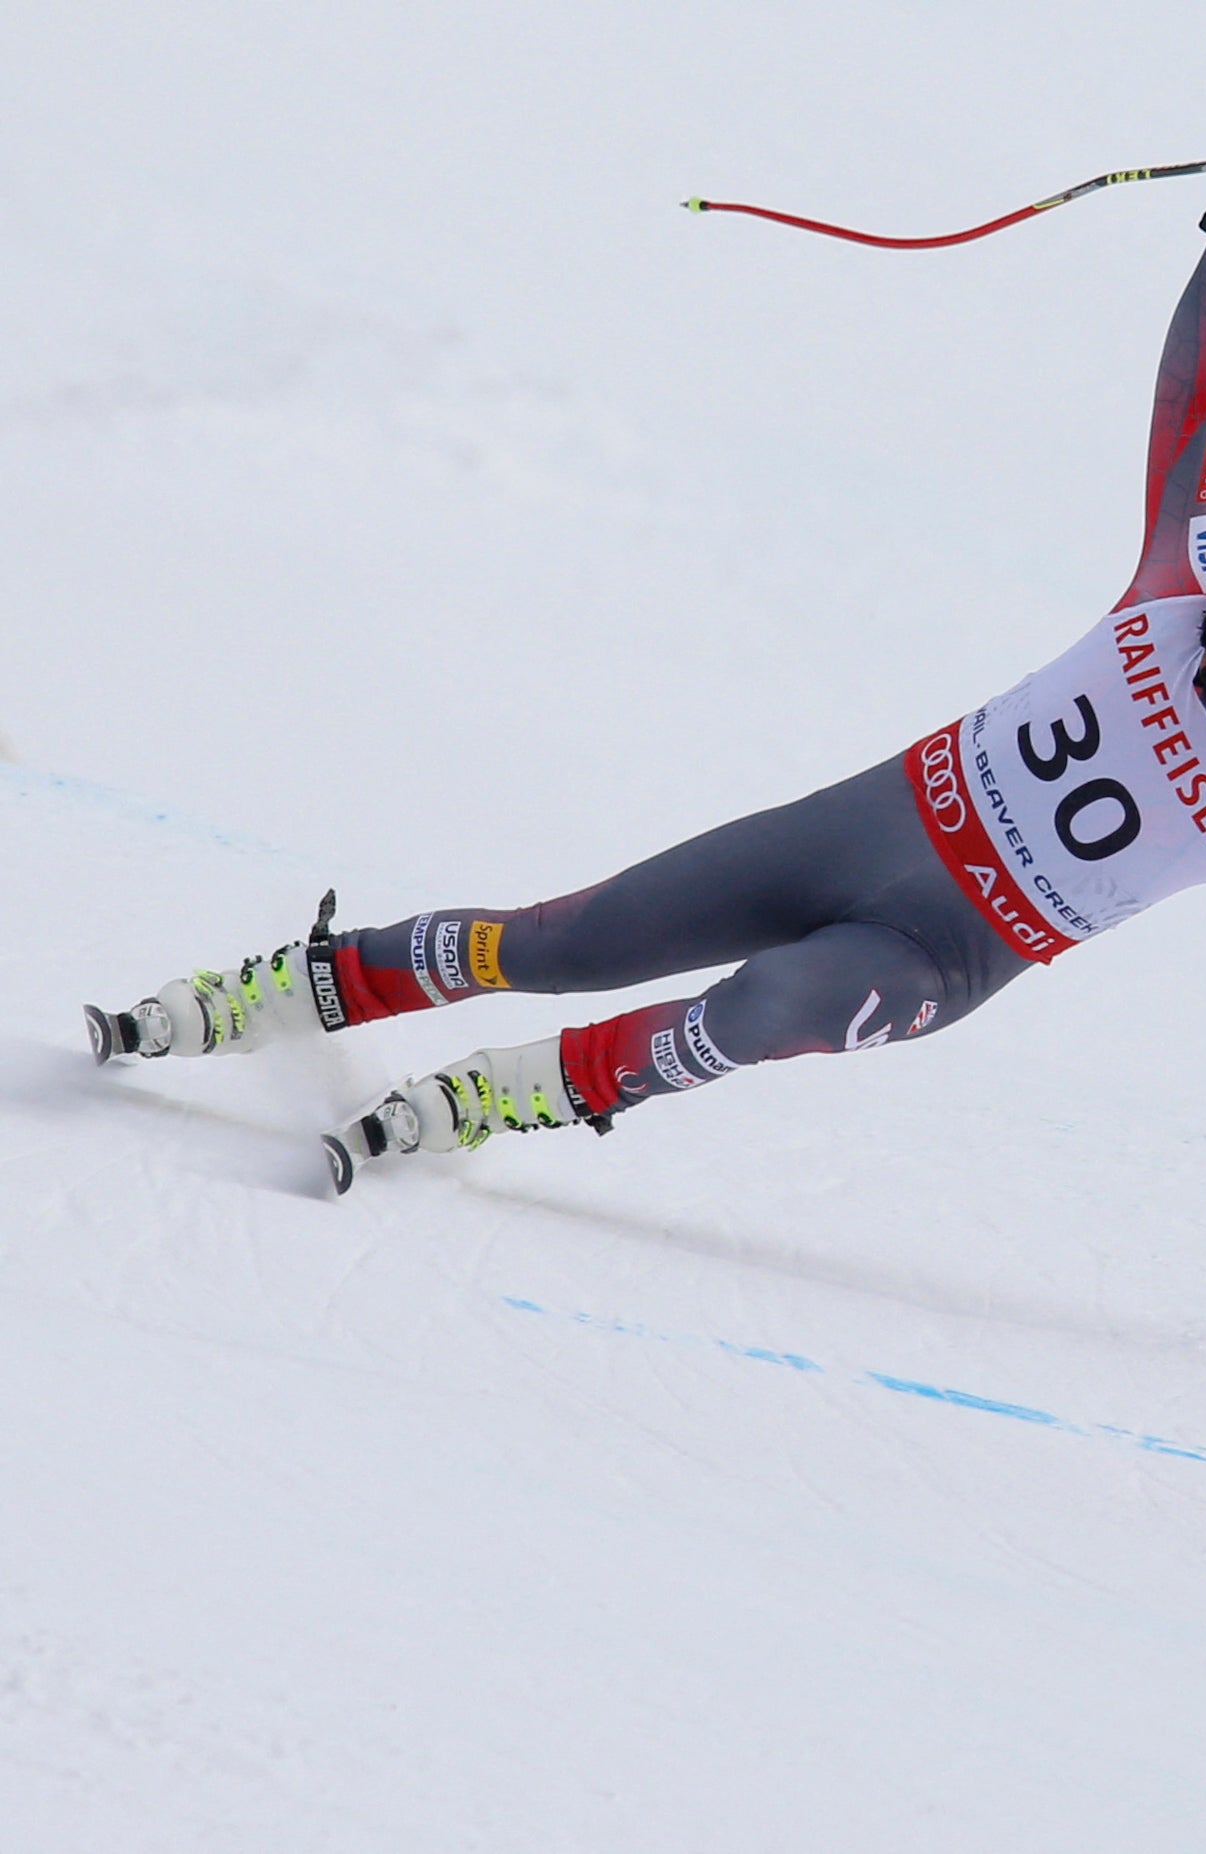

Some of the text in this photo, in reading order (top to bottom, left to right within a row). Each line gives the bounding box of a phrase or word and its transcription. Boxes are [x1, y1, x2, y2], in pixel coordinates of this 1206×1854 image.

[1017, 694, 1141, 861] 30
[964, 864, 1056, 952] Audi
[1034, 875, 1099, 933] CREEK
[443, 923, 465, 987] USANA
[475, 924, 494, 971] Sprint
[311, 962, 346, 1027] BOOSTER
[663, 1033, 684, 1076] HIGH
